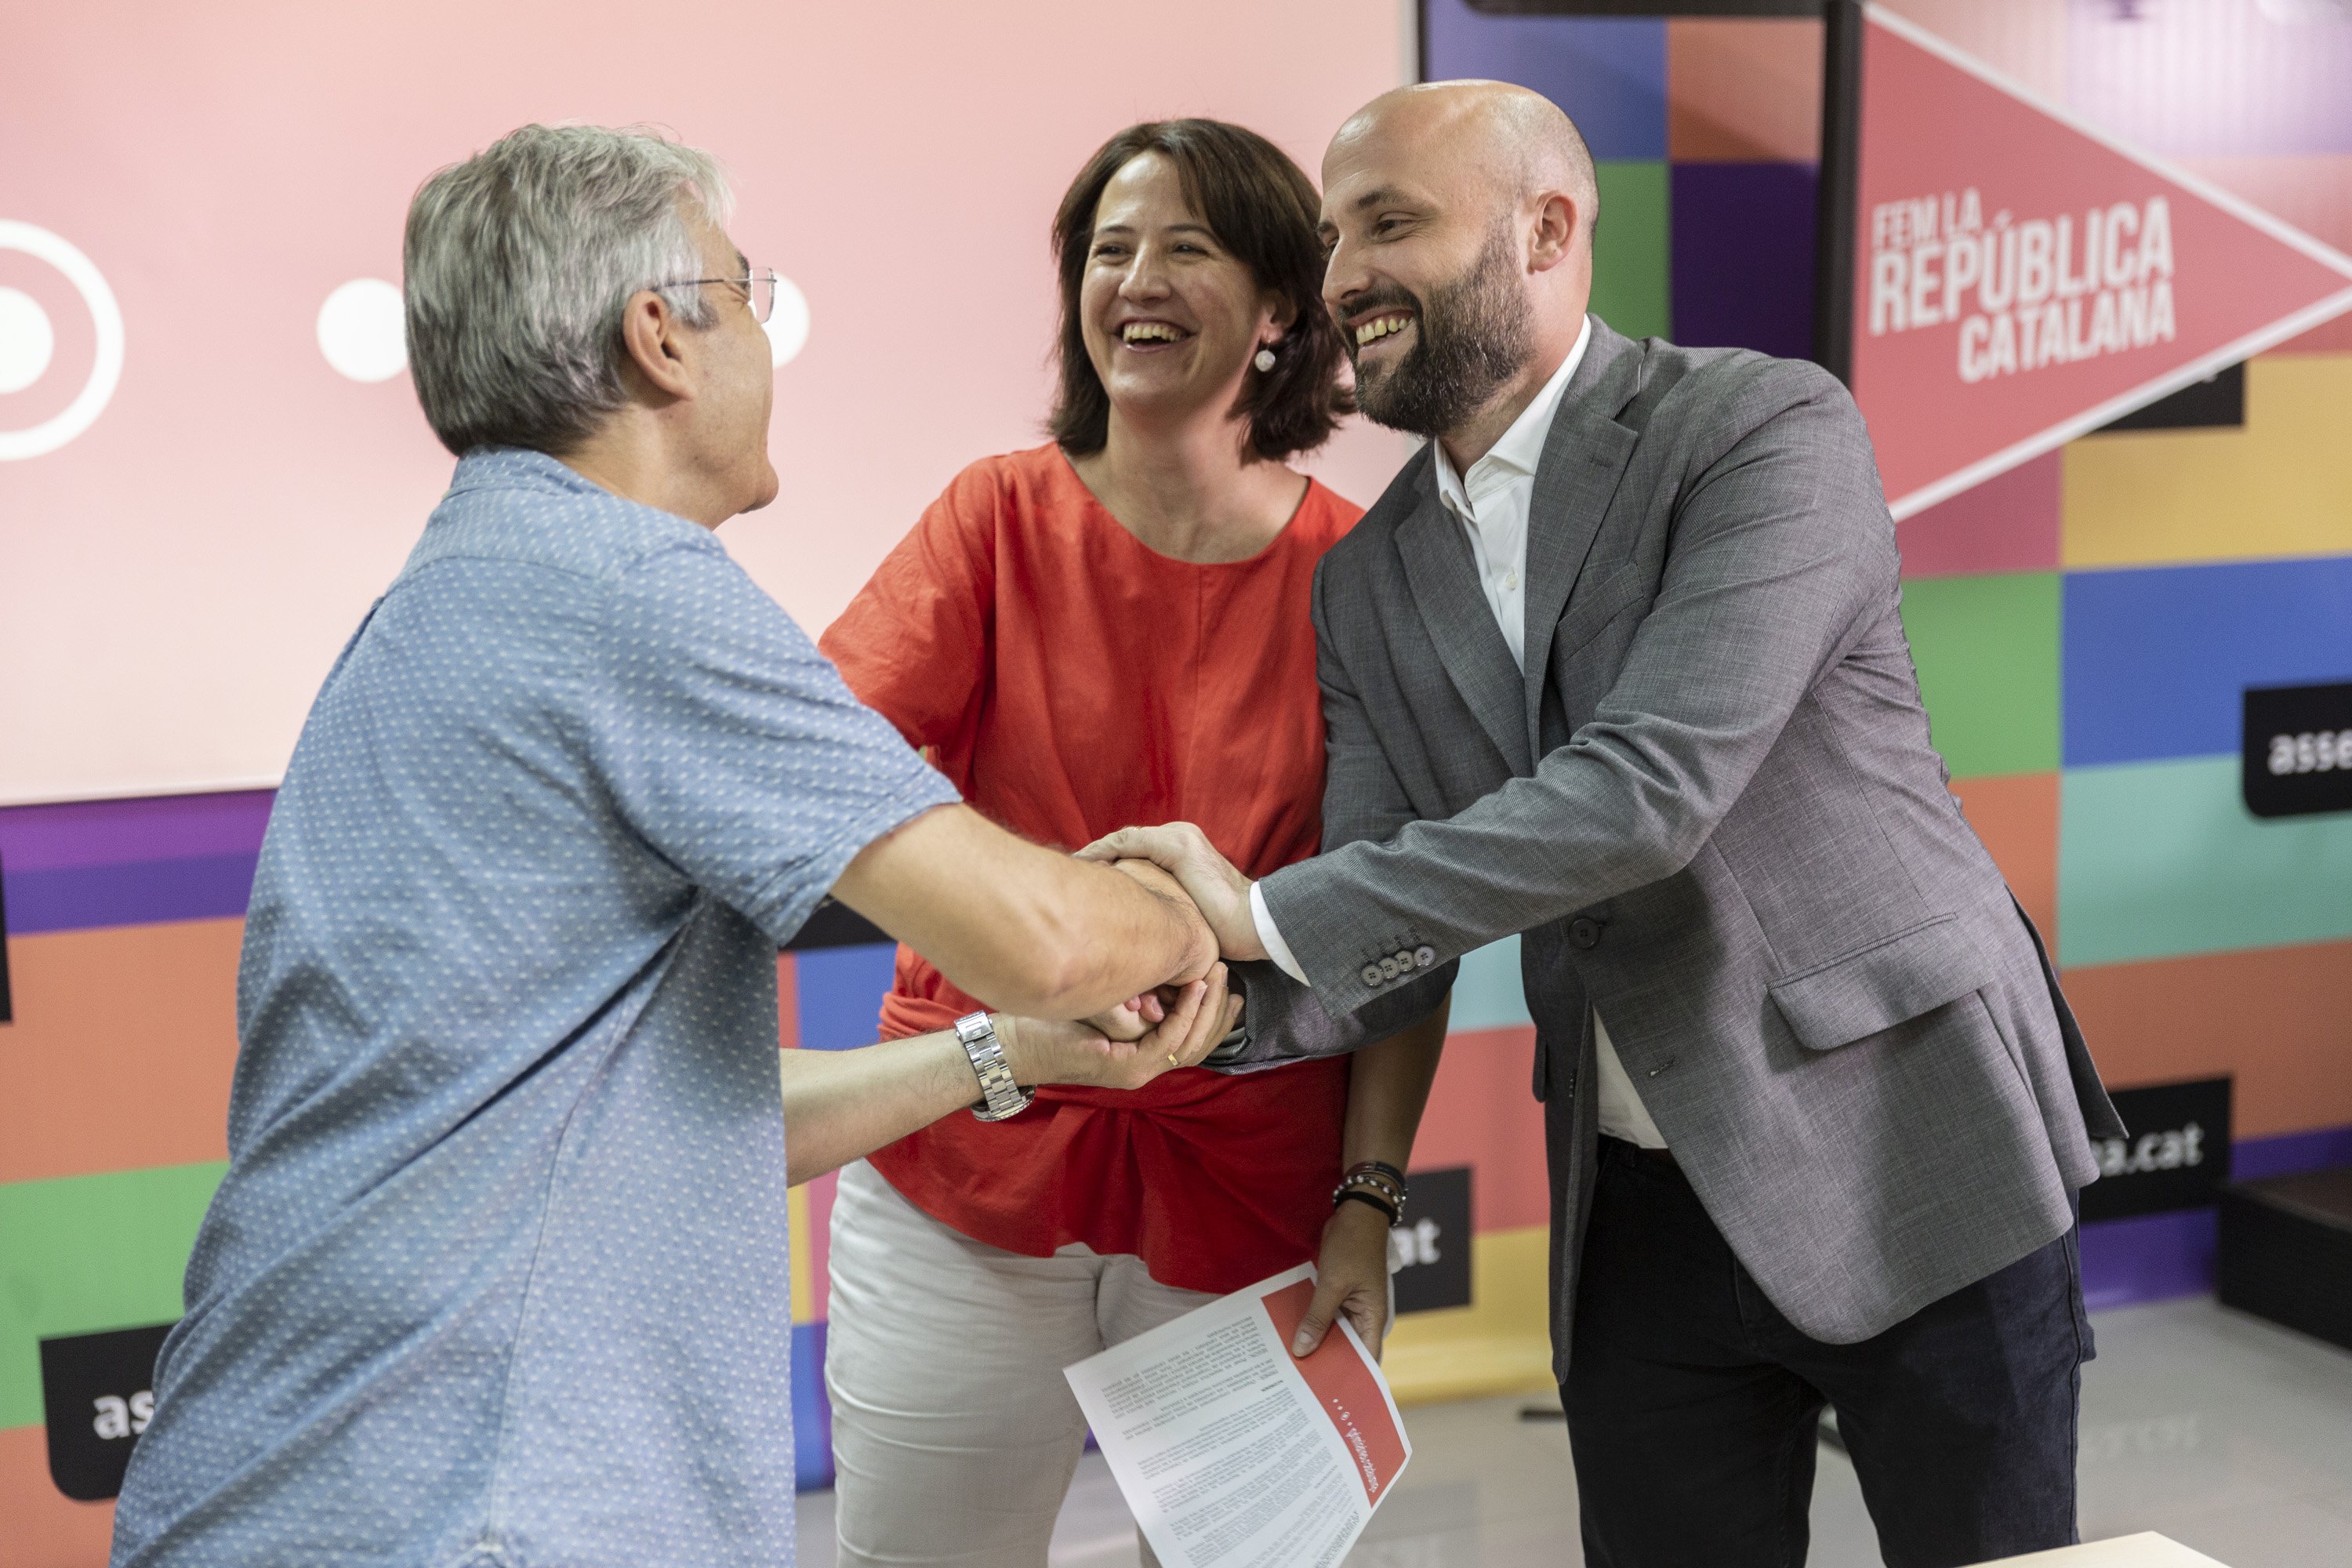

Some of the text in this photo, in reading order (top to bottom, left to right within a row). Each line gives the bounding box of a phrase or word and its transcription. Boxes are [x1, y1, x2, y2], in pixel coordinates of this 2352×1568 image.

[1870, 194, 2174, 336] REPÚBLICA
[1871, 187, 1984, 252] FEM LA
[1958, 278, 2176, 383] CATALANA
